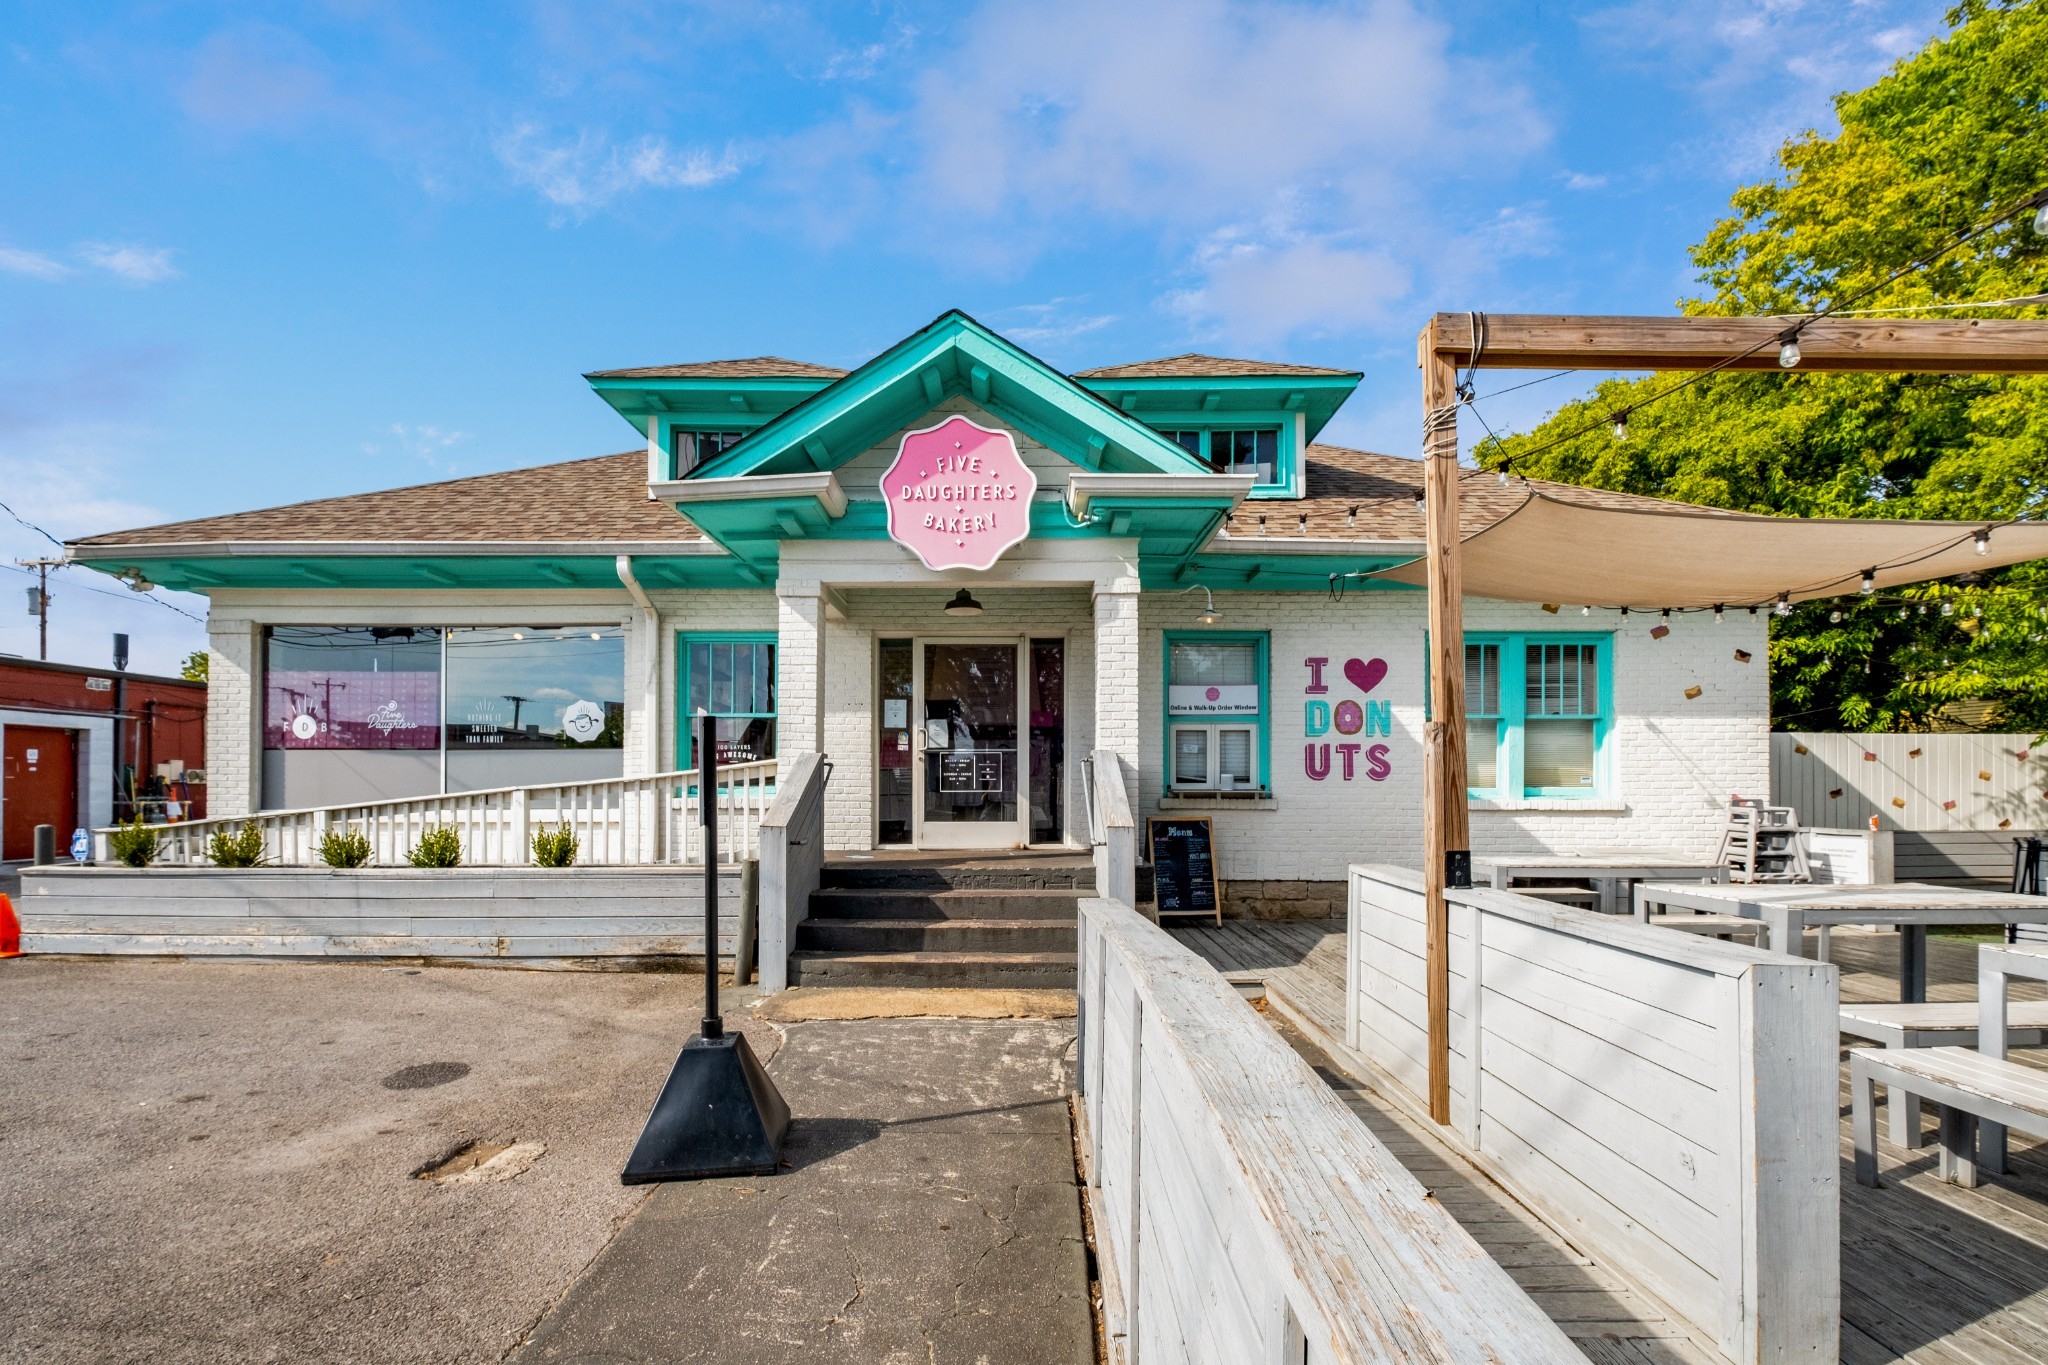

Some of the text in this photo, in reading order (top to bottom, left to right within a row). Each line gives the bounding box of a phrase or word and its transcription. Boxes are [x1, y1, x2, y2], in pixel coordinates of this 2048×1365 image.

[936, 455, 982, 474] FIVE
[902, 484, 1017, 501] DAUGHTERS
[923, 512, 997, 534] BAKERY
[1305, 657, 1329, 694] I
[378, 703, 403, 721] Five
[1194, 704, 1217, 712] Walk-Up
[1234, 703, 1258, 711] Window
[367, 713, 418, 730] Daughters
[467, 714, 502, 722] NOTHING IS
[471, 724, 498, 733] SWEETER
[465, 735, 504, 743] THAN FAMILY
[724, 752, 757, 760] AWESOME
[1305, 743, 1392, 781] UTS
[1168, 826, 1194, 837] Menu
